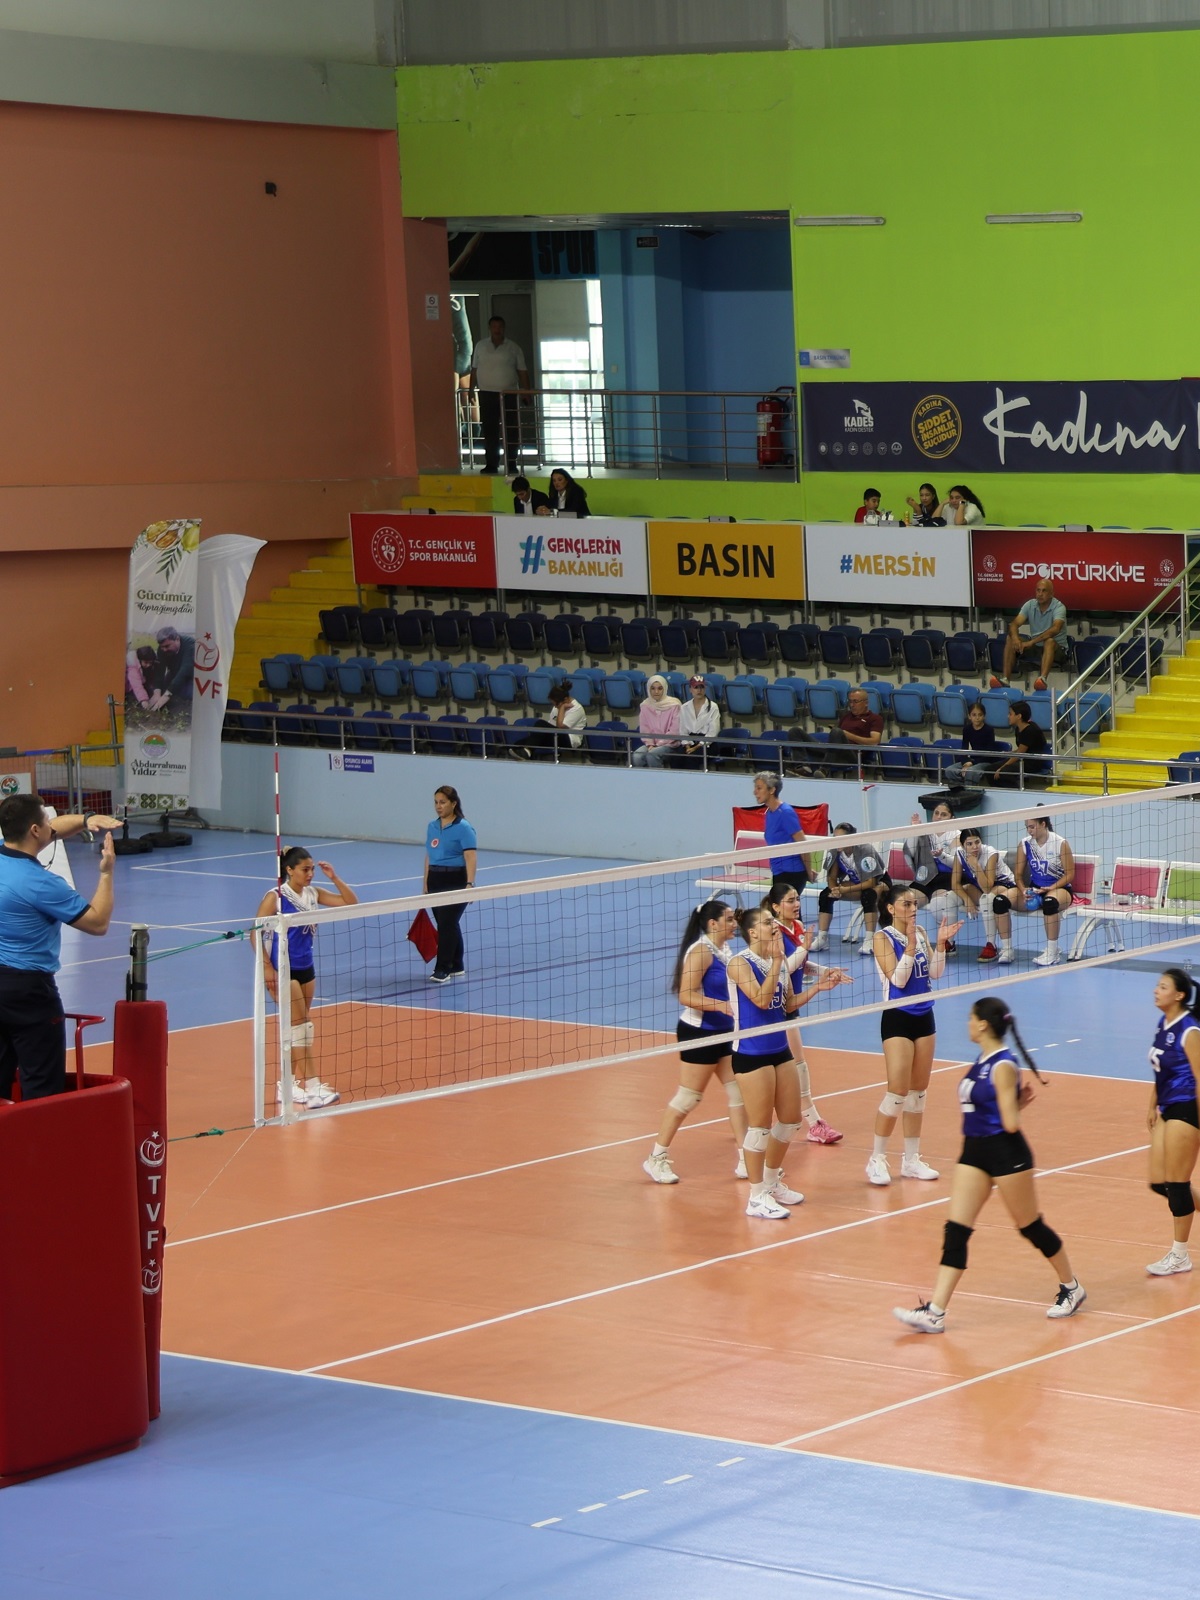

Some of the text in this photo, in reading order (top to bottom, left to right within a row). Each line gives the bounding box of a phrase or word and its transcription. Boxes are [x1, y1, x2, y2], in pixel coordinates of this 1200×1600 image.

[917, 400, 943, 417] KADINA
[844, 416, 874, 427] KADES
[983, 387, 1187, 465] Kadına
[923, 429, 958, 450] SUÇUDUR
[408, 539, 476, 553] T.C. GENÇLİK VE
[409, 550, 478, 563] SPOR BAKANLIĞI
[677, 542, 776, 579] BASIN
[839, 550, 936, 578] #MERSİN
[548, 557, 624, 579] BAKANLIĞI
[1010, 560, 1146, 583] SPORTÜRKİYE
[137, 589, 193, 603] Gücümüz
[194, 677, 223, 699] VF
[130, 758, 187, 770] Abdurrahman
[132, 767, 157, 776] Yıldız
